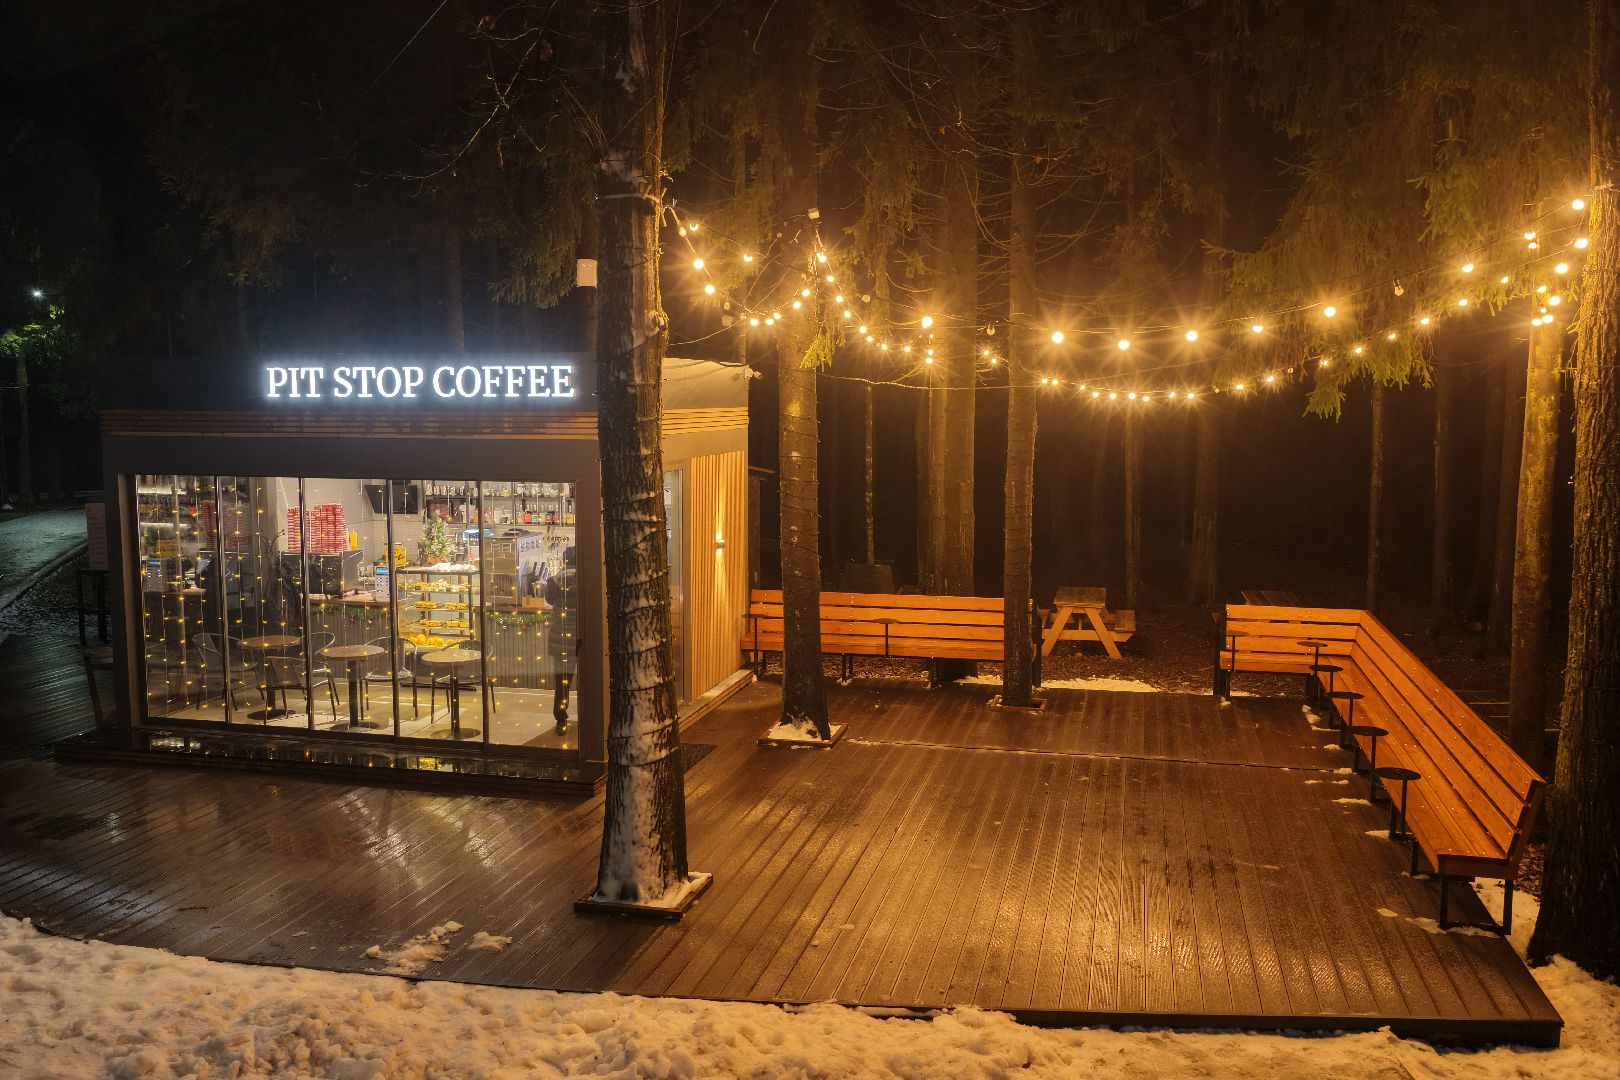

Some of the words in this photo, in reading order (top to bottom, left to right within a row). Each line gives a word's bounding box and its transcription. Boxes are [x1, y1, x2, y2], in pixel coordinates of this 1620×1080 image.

[266, 367, 324, 398] PIT
[333, 366, 424, 398] STOP
[432, 366, 575, 398] COFFEE
